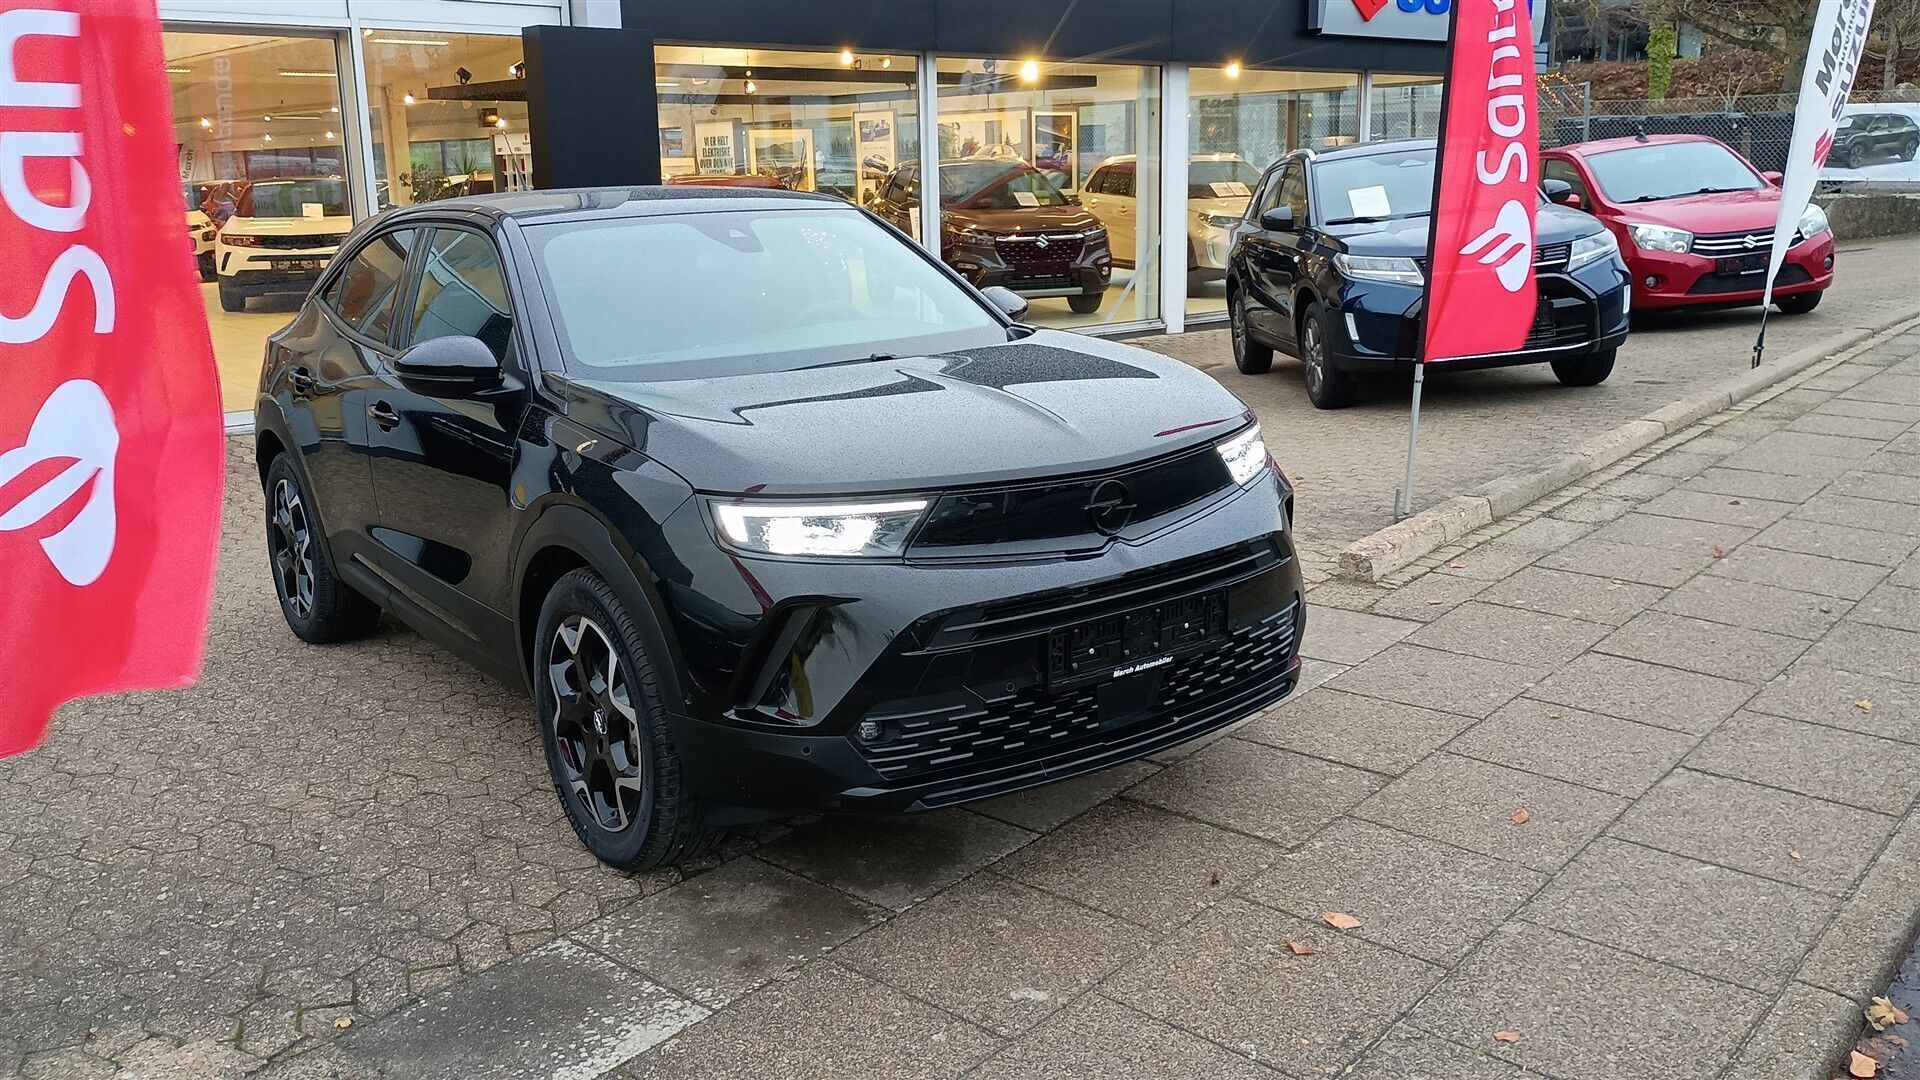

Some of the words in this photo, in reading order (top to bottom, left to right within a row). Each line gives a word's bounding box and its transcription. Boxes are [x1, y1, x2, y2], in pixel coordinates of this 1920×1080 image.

[710, 136, 716, 146] ER
[717, 135, 728, 146] HELT
[702, 147, 731, 158] ELEKTRISKE
[700, 158, 712, 168] OVER
[713, 158, 723, 168] DEN
[724, 157, 734, 168] NYE
